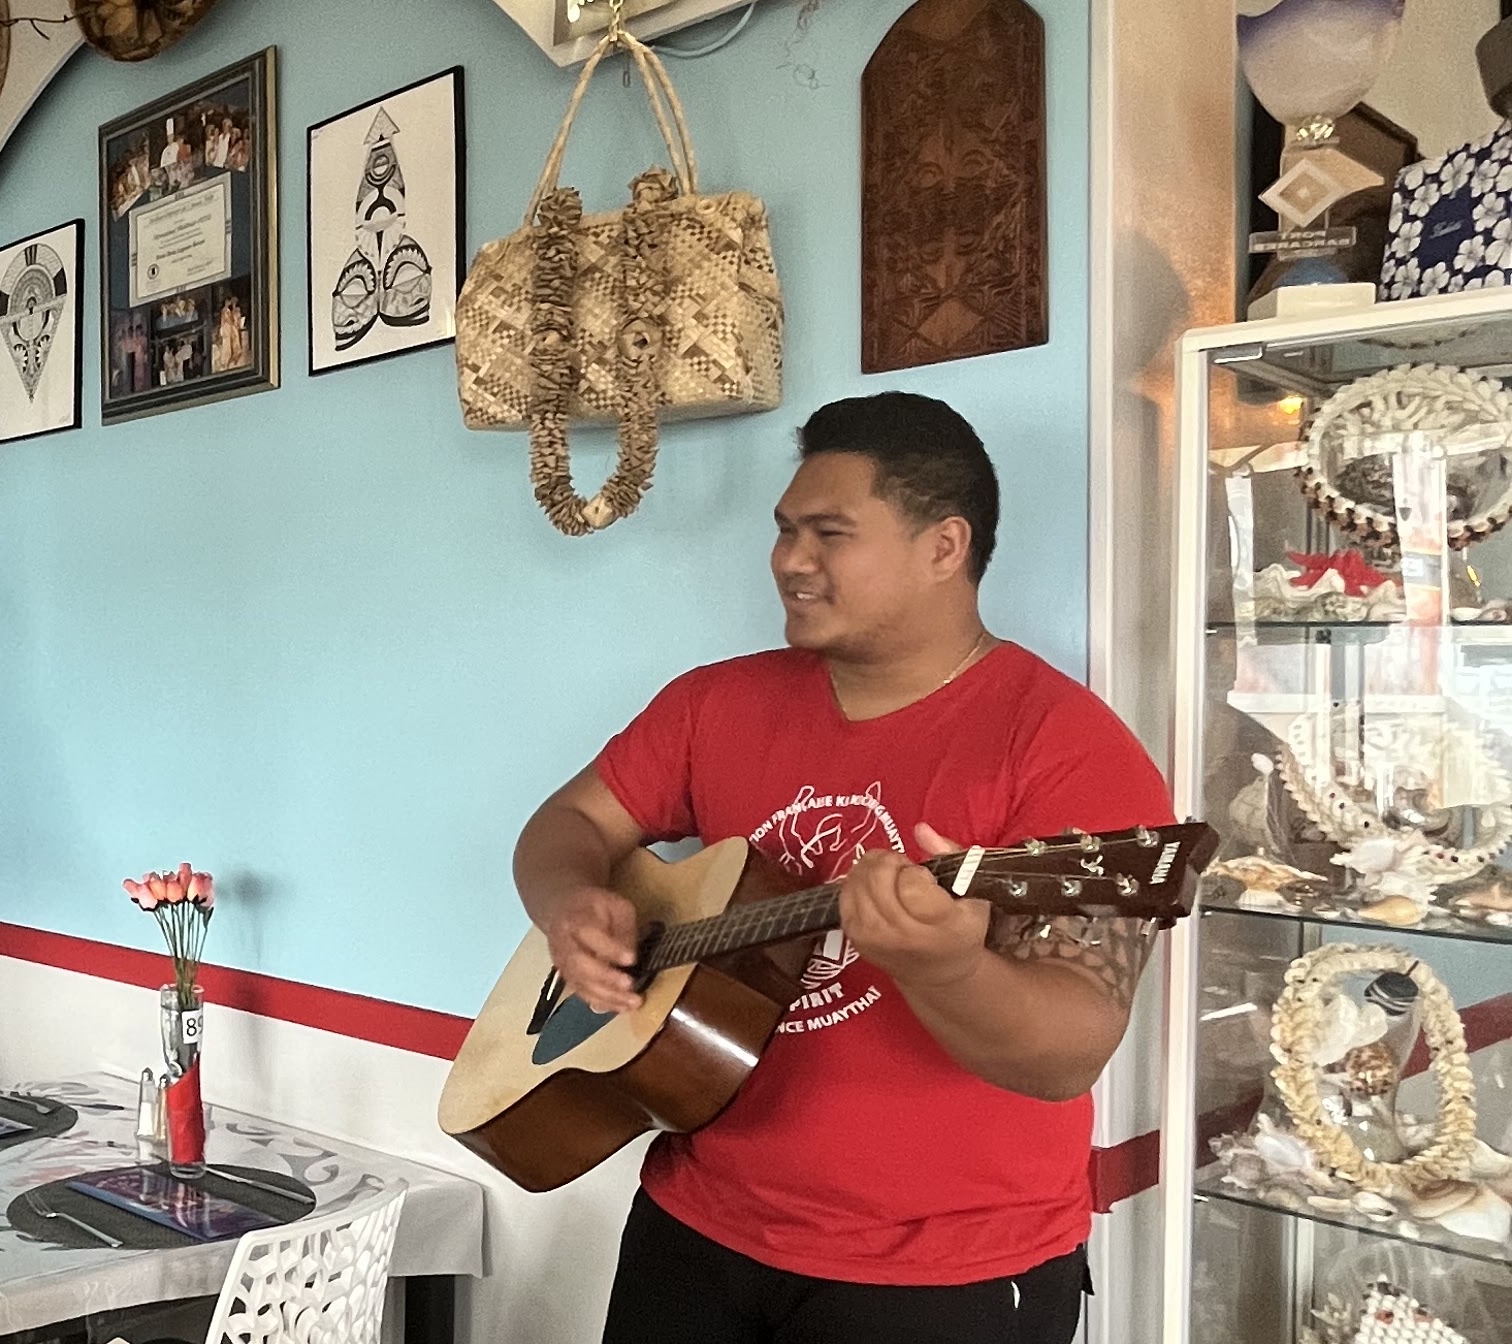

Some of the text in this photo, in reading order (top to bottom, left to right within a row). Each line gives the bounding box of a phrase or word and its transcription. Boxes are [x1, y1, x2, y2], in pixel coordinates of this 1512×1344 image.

[749, 821, 774, 843] ION
[1149, 841, 1181, 884] YAMAHA
[775, 985, 882, 1034] NCE MUAYTHAI
[789, 982, 846, 1012] PIRIT
